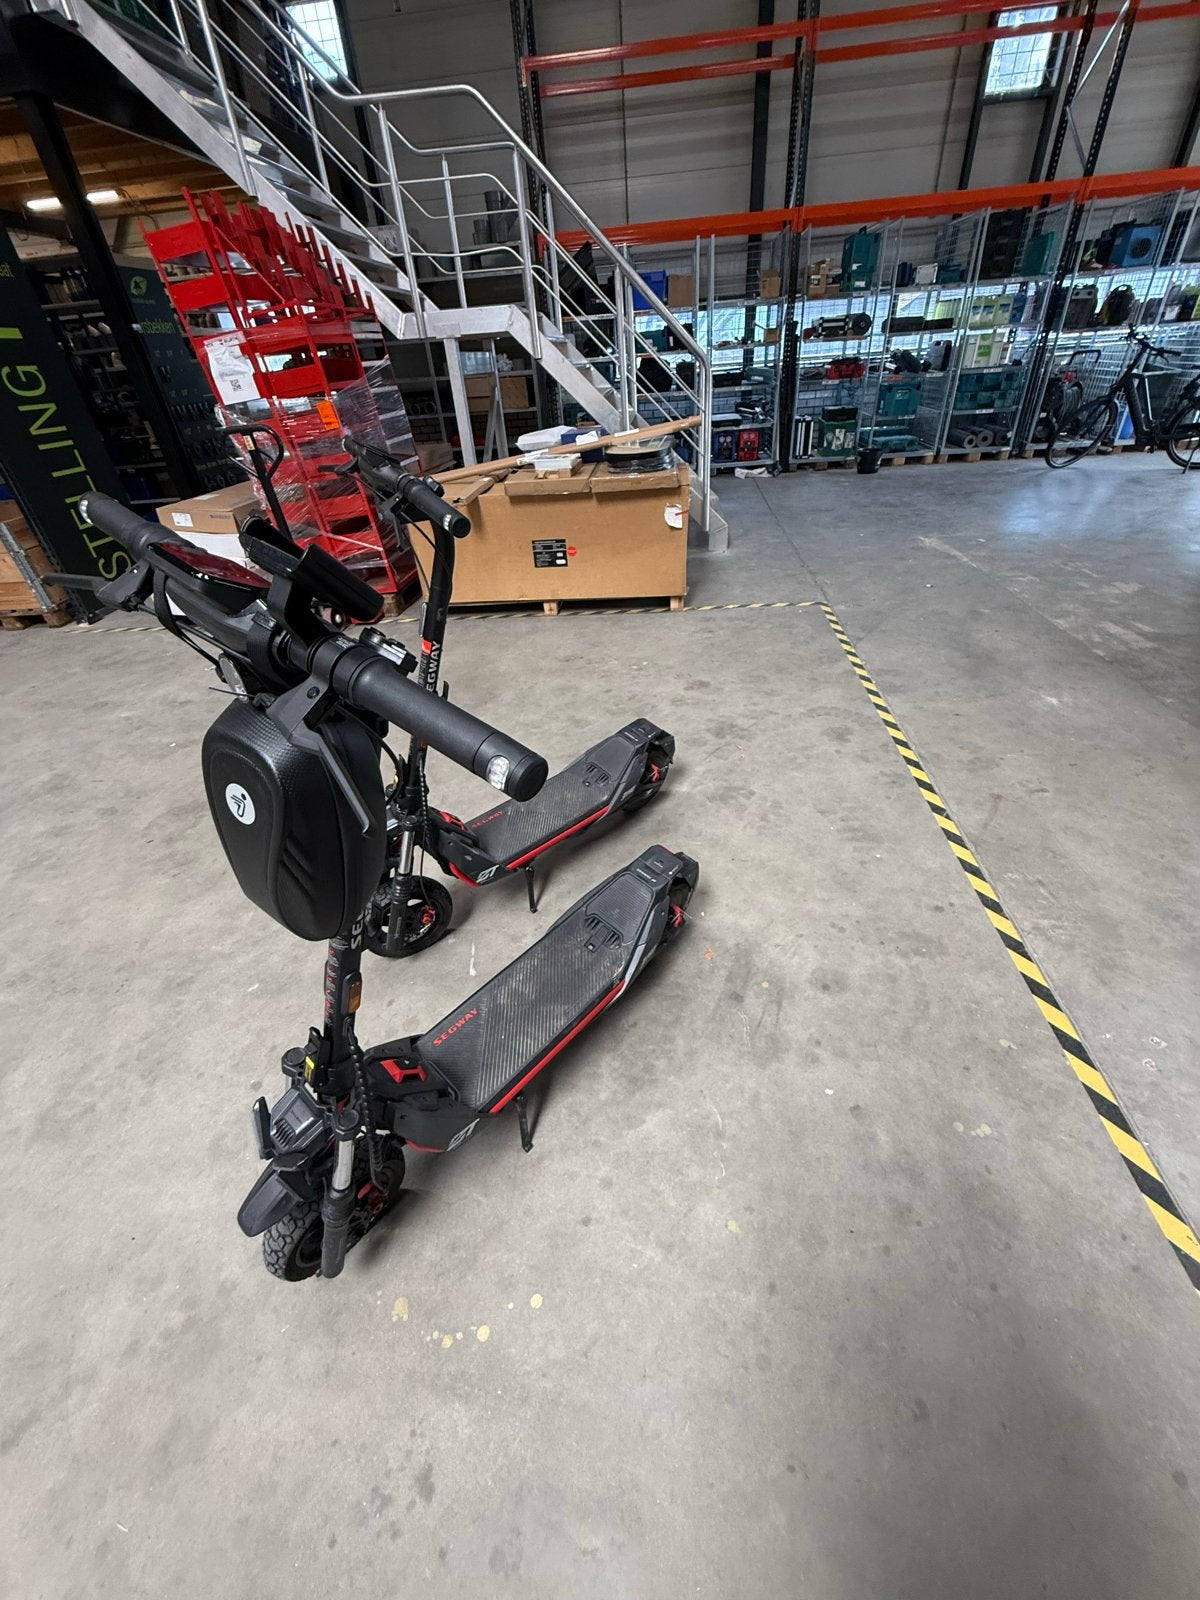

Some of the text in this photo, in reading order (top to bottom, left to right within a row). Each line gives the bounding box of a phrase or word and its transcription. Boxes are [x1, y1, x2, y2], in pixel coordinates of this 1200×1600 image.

[426, 641, 441, 692] EGWAY
[471, 810, 503, 829] SEGWAY
[433, 1007, 478, 1047] SEGWAY
